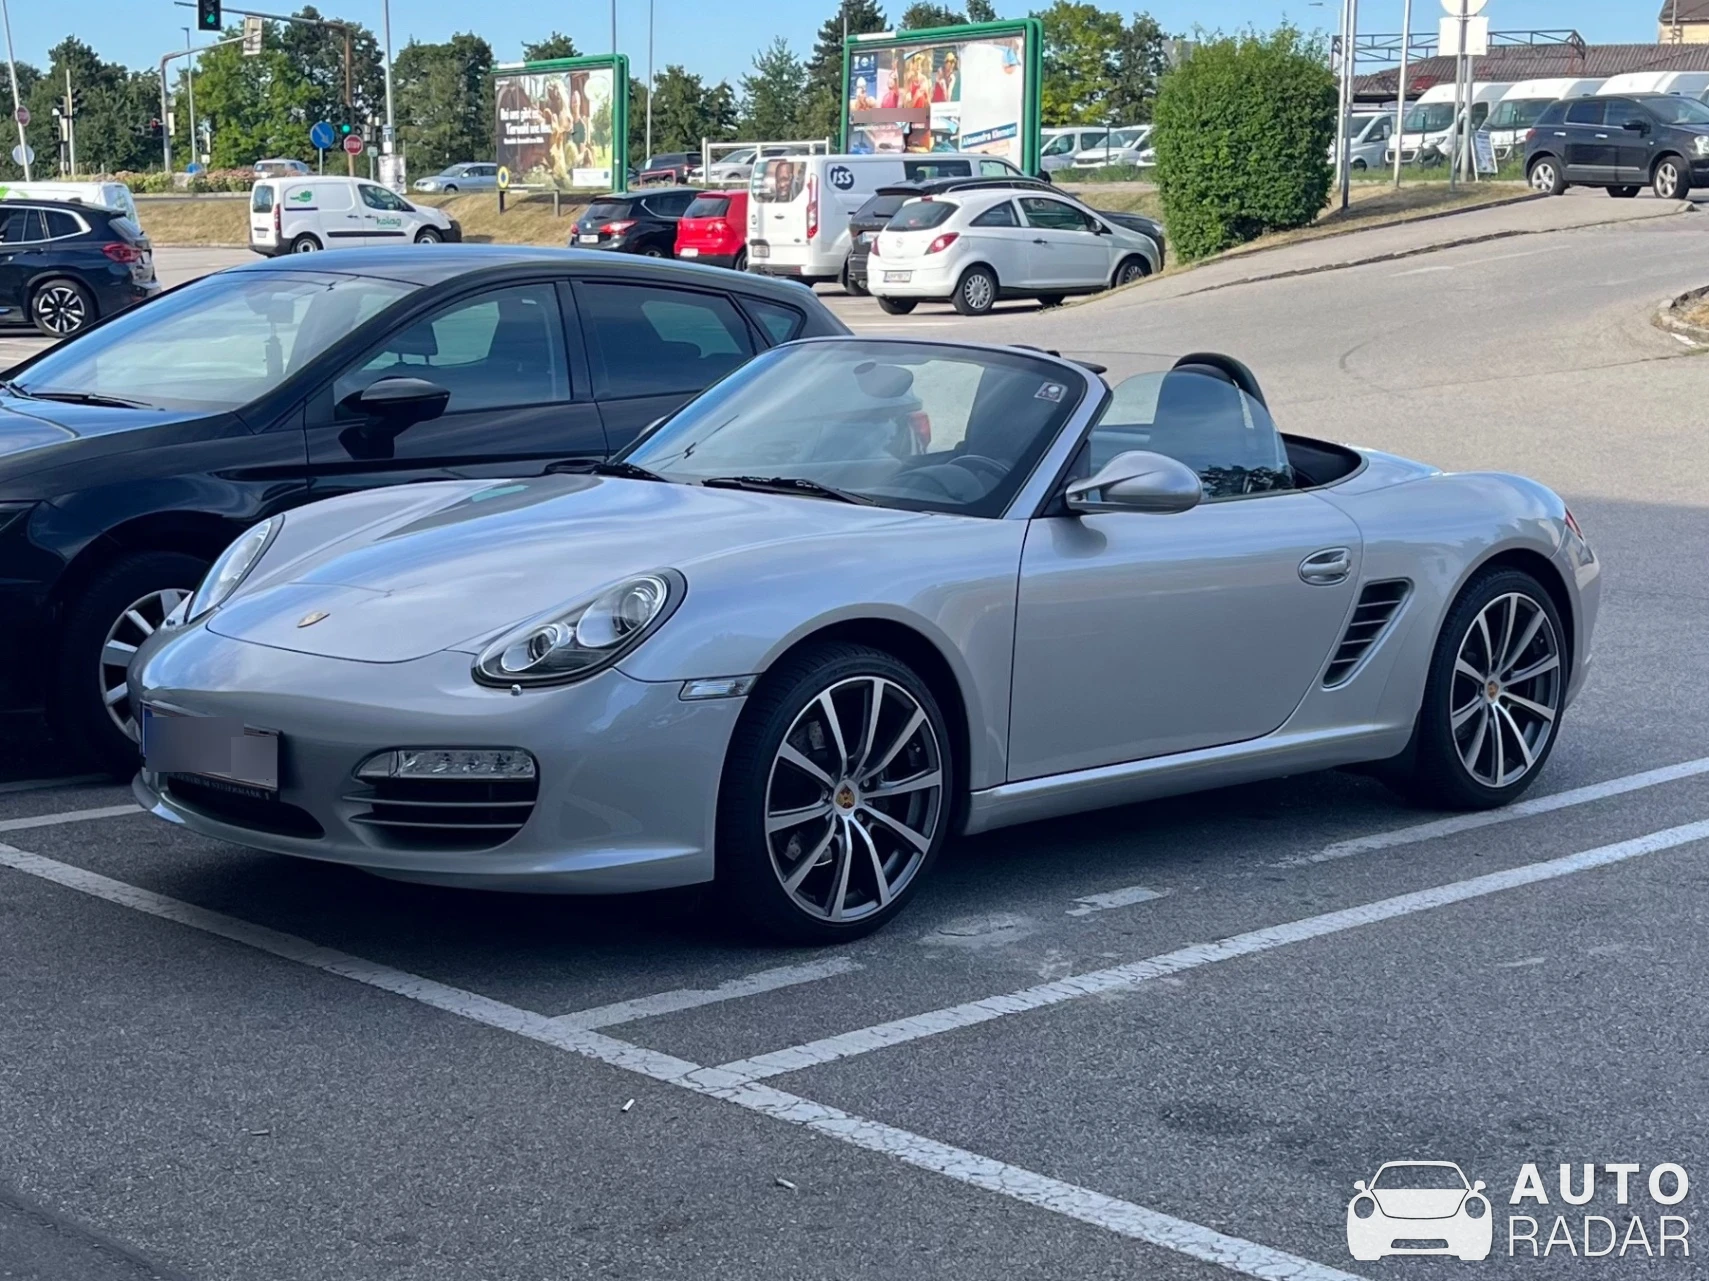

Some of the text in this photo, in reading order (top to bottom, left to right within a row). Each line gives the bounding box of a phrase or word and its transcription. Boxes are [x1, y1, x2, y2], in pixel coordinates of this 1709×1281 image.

[346, 140, 361, 149] STOP
[962, 132, 991, 146] Alexandra
[833, 171, 852, 184] ISS
[211, 781, 262, 799] STEIERMARK
